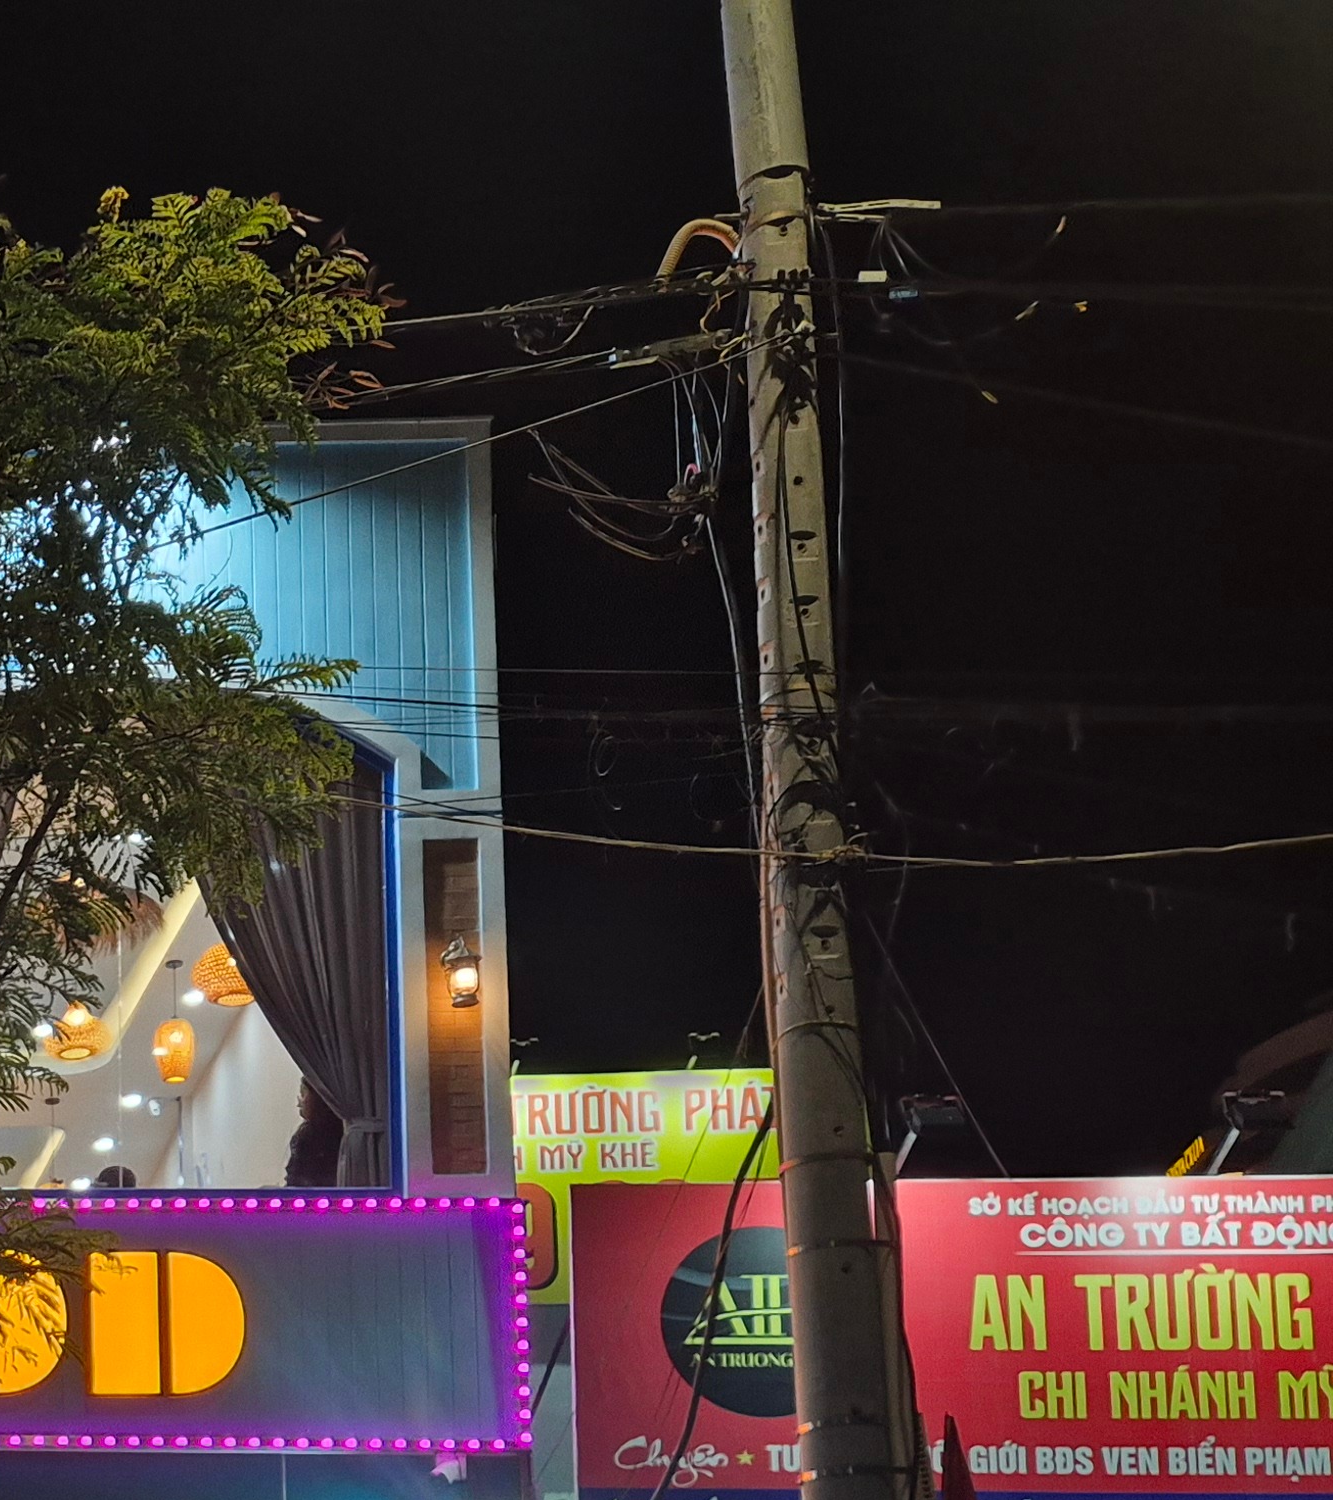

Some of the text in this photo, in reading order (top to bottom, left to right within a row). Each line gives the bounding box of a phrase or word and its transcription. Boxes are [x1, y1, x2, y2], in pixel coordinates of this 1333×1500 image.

[969, 1191, 1001, 1216] SỞ
[1008, 1191, 1039, 1216] KẾ
[1224, 1191, 1304, 1214] THÀNH
[1020, 1211, 1333, 1250] CÔNG TY BẤT ĐỘN
[970, 1262, 1315, 1351] AN TRƯỜNG
[1018, 1371, 1088, 1420] CHI
[1109, 1364, 1257, 1420] NHÁNH
[969, 1440, 1027, 1475] GIỚI
[1036, 1446, 1095, 1475] BĐS
[1101, 1446, 1160, 1476] VEN
[1168, 1436, 1236, 1476] BIỂN
[1245, 1446, 1332, 1483] PHẠM
